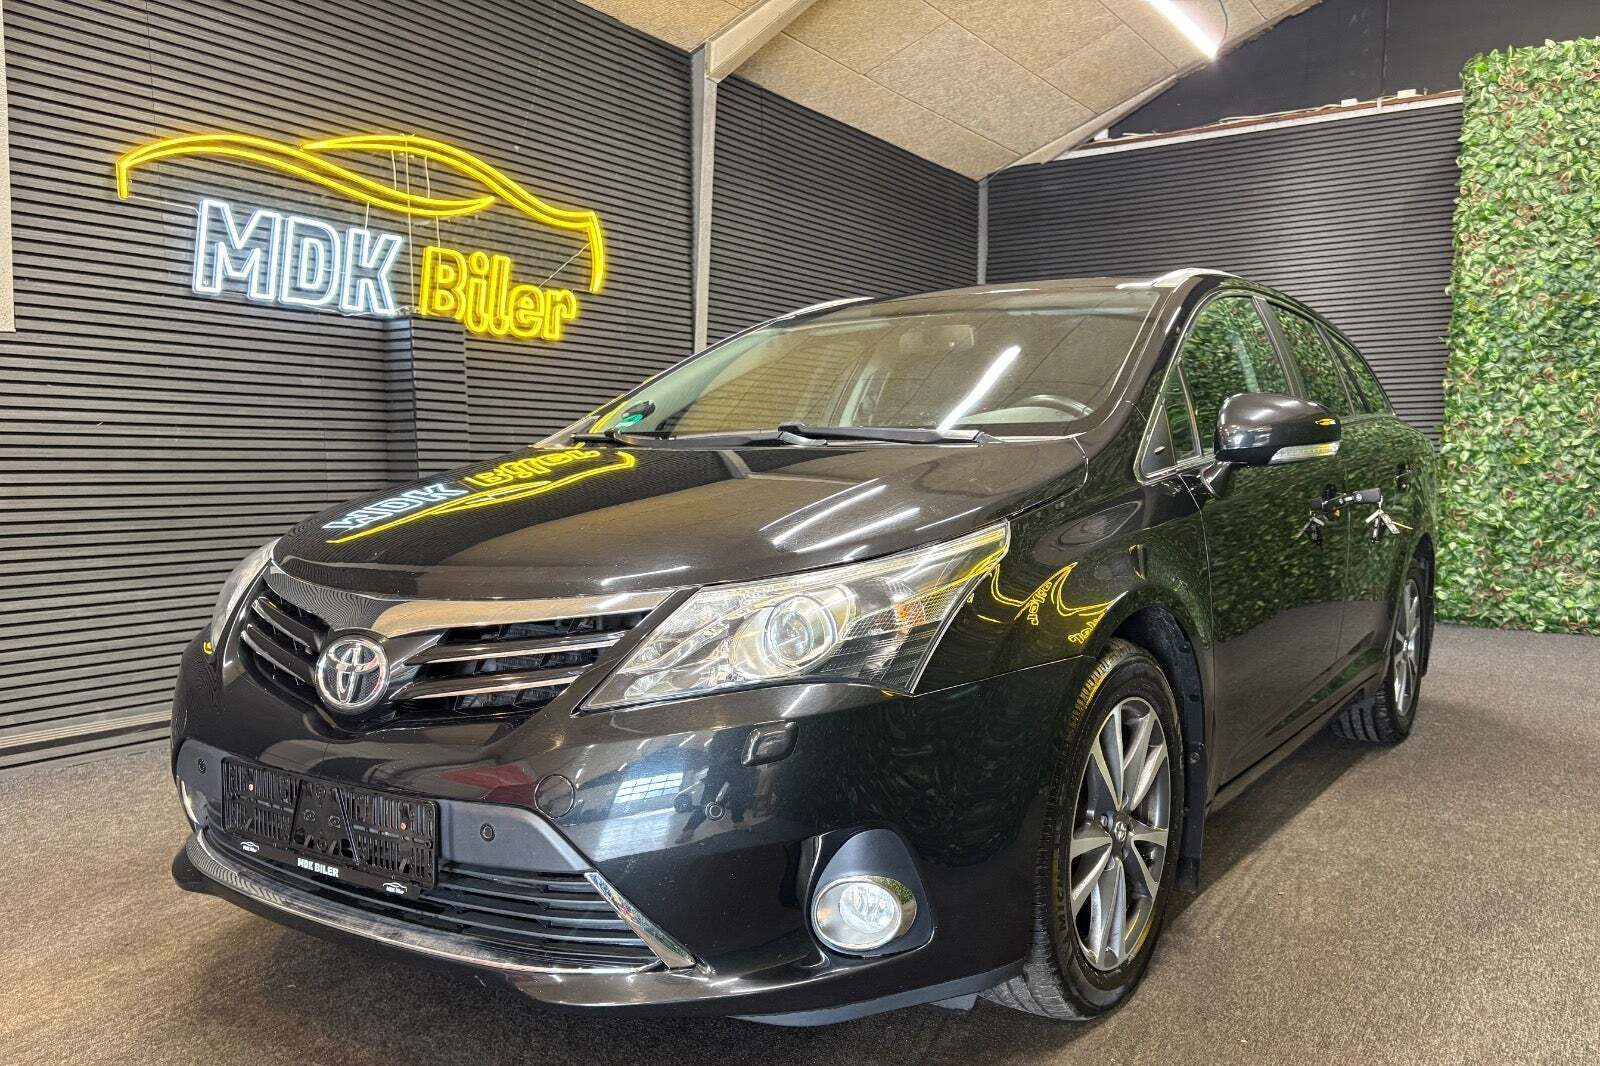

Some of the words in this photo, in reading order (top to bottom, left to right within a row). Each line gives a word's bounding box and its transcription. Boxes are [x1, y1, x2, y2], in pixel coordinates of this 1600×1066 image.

[192, 198, 404, 317] MDK
[419, 245, 578, 341] Biler
[314, 862, 340, 878] BILER
